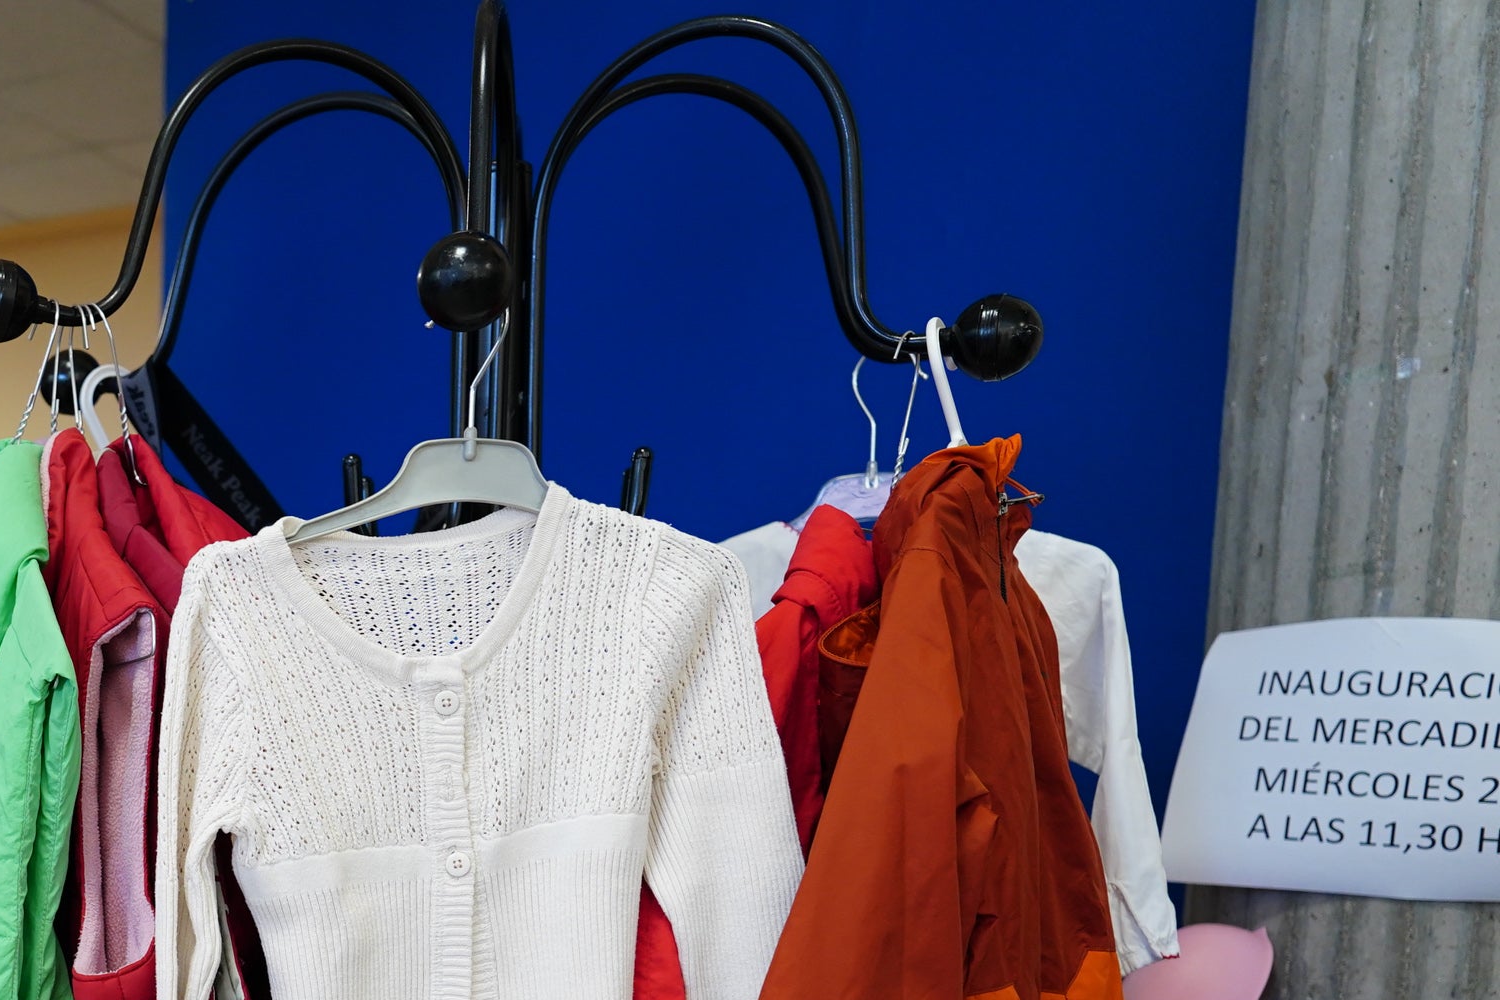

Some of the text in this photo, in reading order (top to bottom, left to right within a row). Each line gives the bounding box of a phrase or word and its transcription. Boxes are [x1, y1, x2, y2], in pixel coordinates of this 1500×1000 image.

[220, 473, 261, 528] Peak
[1257, 669, 1500, 699] INAUGURACI
[1238, 716, 1300, 743] DEL
[1254, 761, 1465, 803] MIÉRCOLES
[1246, 814, 1270, 840] A
[1283, 815, 1346, 844] LAS
[1358, 819, 1464, 855] 11,30
